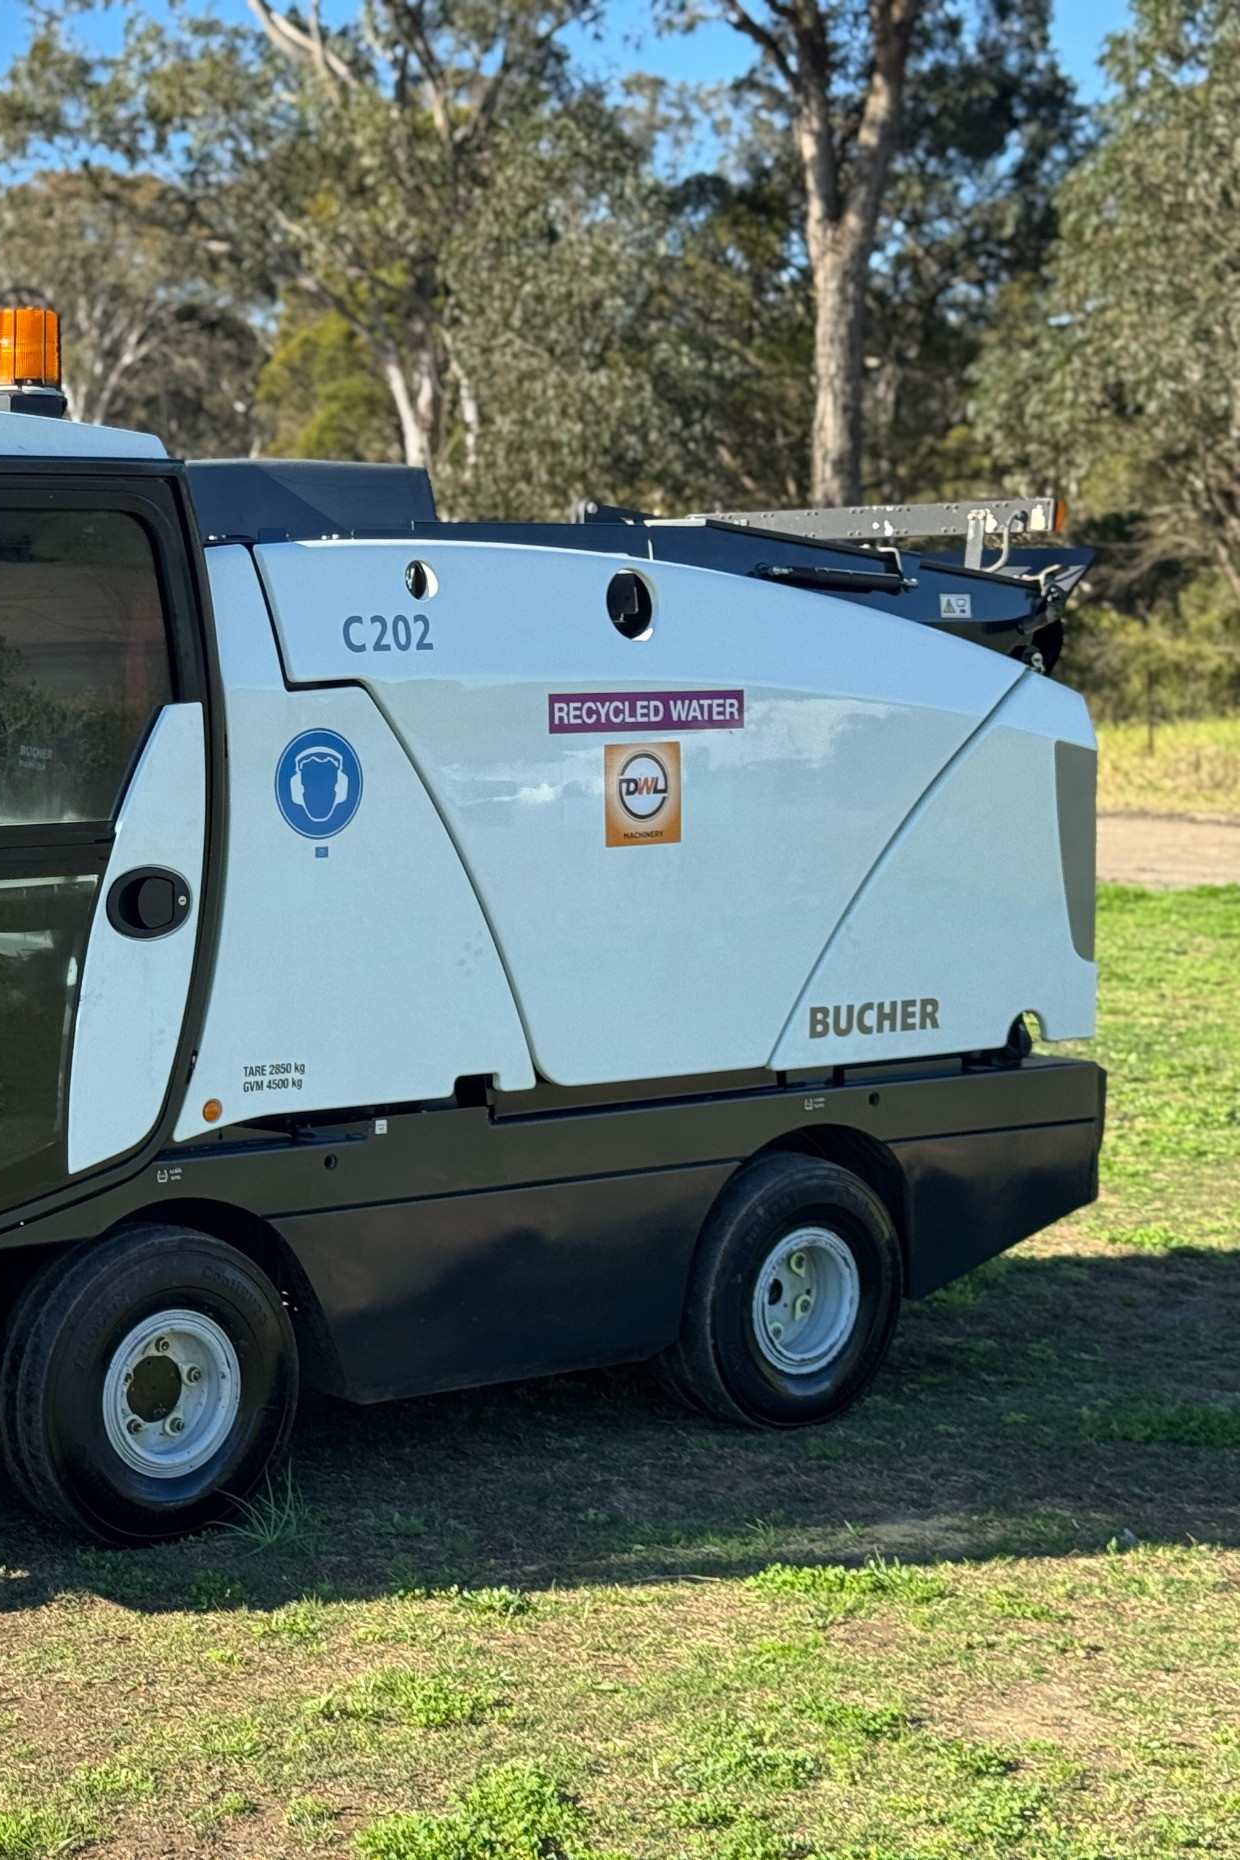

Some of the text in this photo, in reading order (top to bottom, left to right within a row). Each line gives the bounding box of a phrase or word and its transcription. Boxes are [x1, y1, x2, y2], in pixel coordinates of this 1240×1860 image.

[342, 614, 434, 653] C202
[554, 699, 740, 724] RECYCLED WATER
[619, 776, 667, 796] DWL
[623, 830, 663, 840] MACHINERY
[809, 998, 939, 1038] BUCHER
[243, 1062, 305, 1077] TARE 2850 kg
[243, 1077, 302, 1092] GVM 4500 kg
